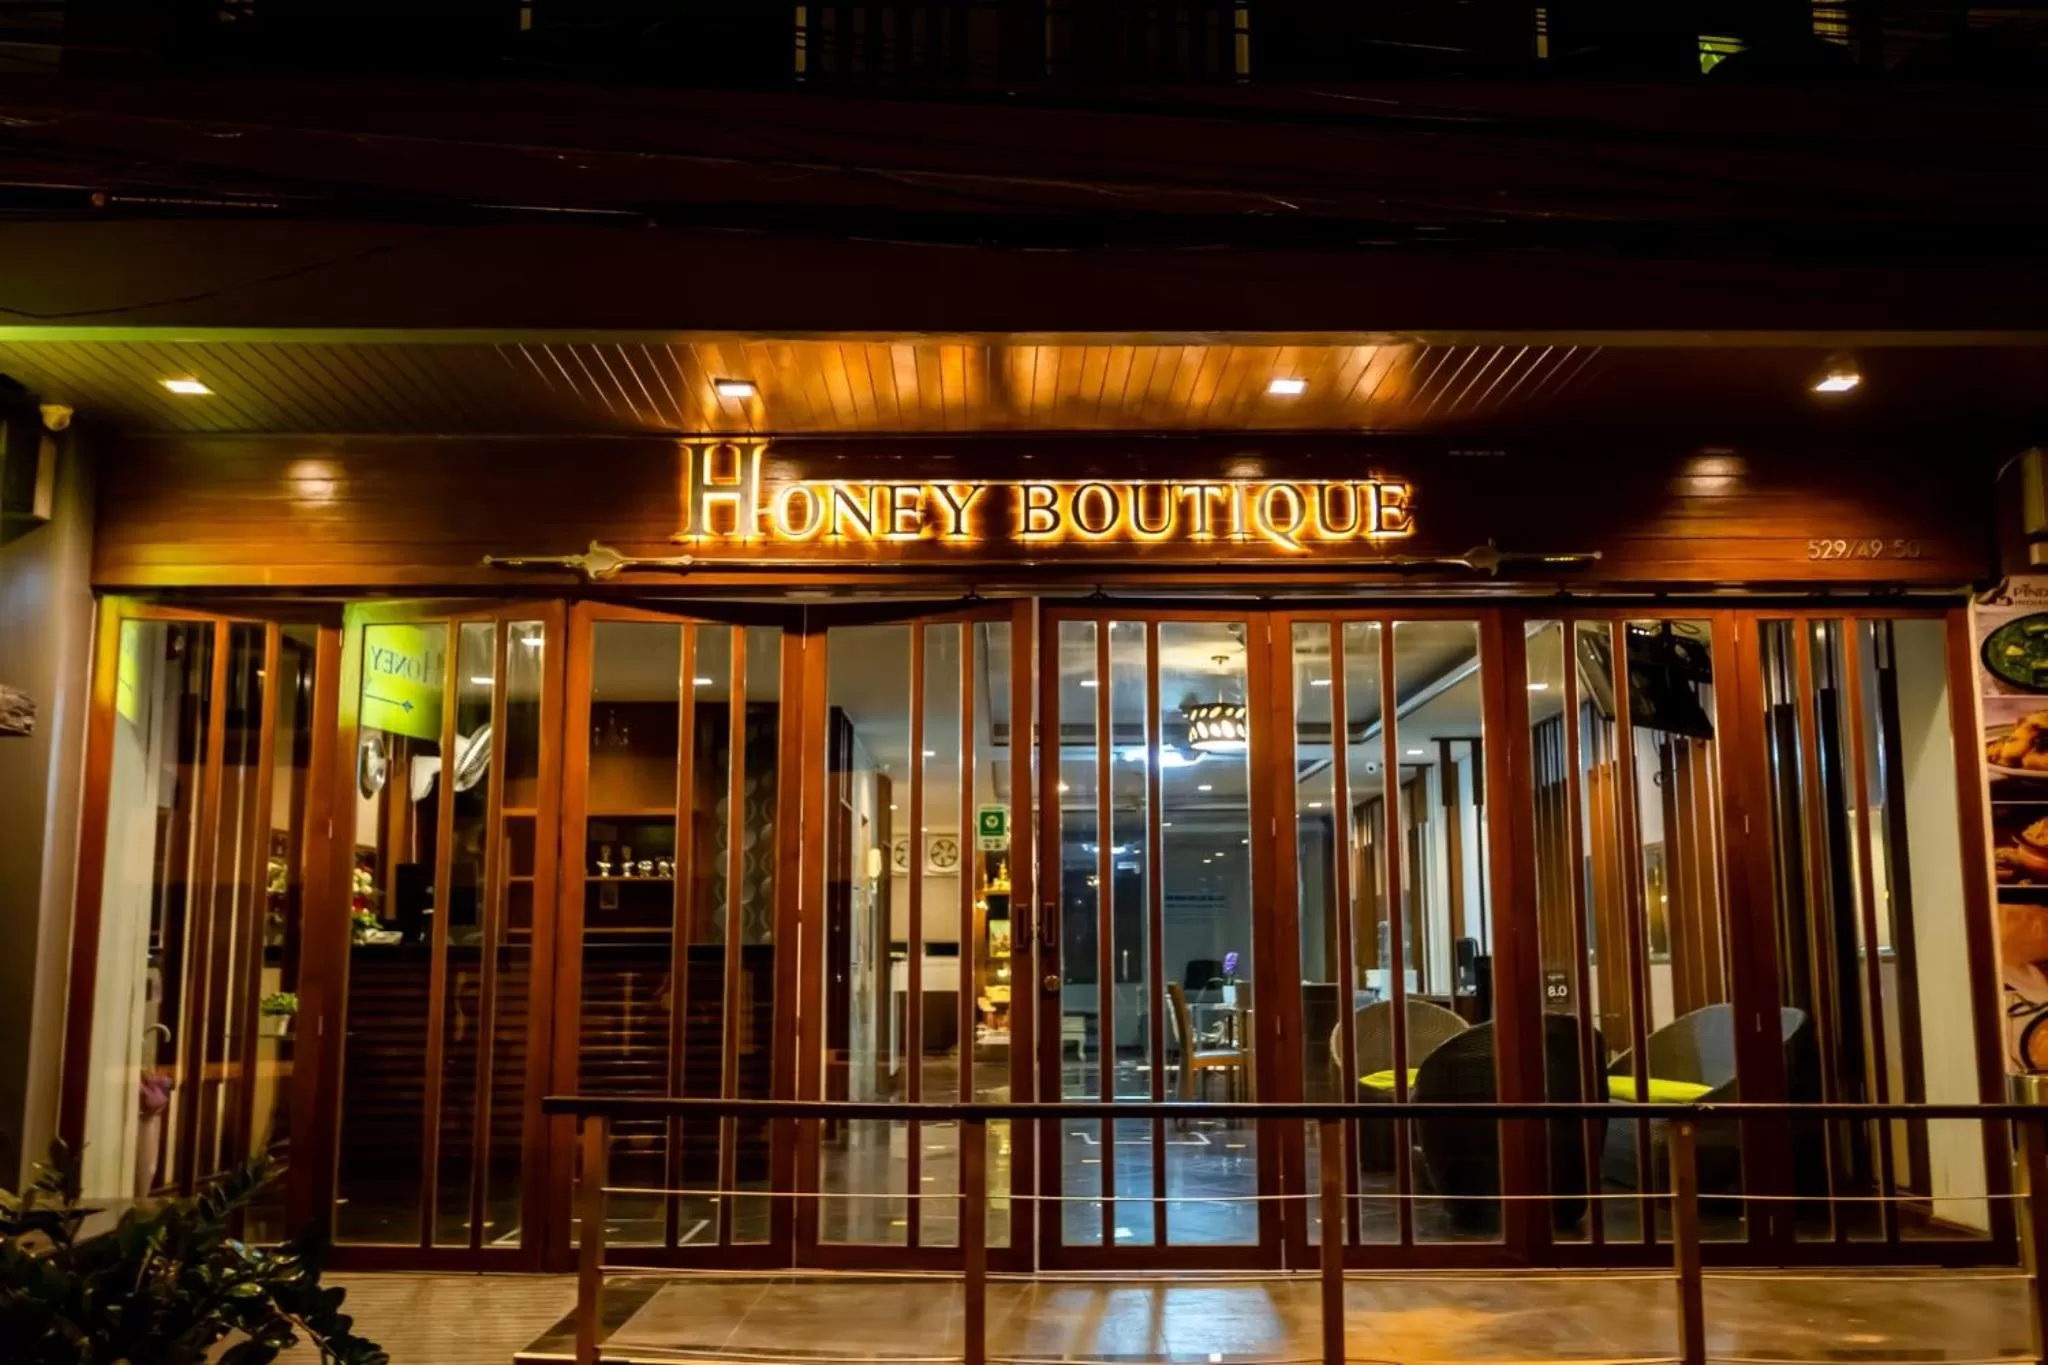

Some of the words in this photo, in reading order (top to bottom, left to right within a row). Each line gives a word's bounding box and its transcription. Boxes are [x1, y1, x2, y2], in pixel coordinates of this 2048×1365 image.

[678, 437, 985, 539] HONEY
[1018, 482, 1413, 553] BOUTIQUE
[1547, 985, 1568, 997] 8.0
